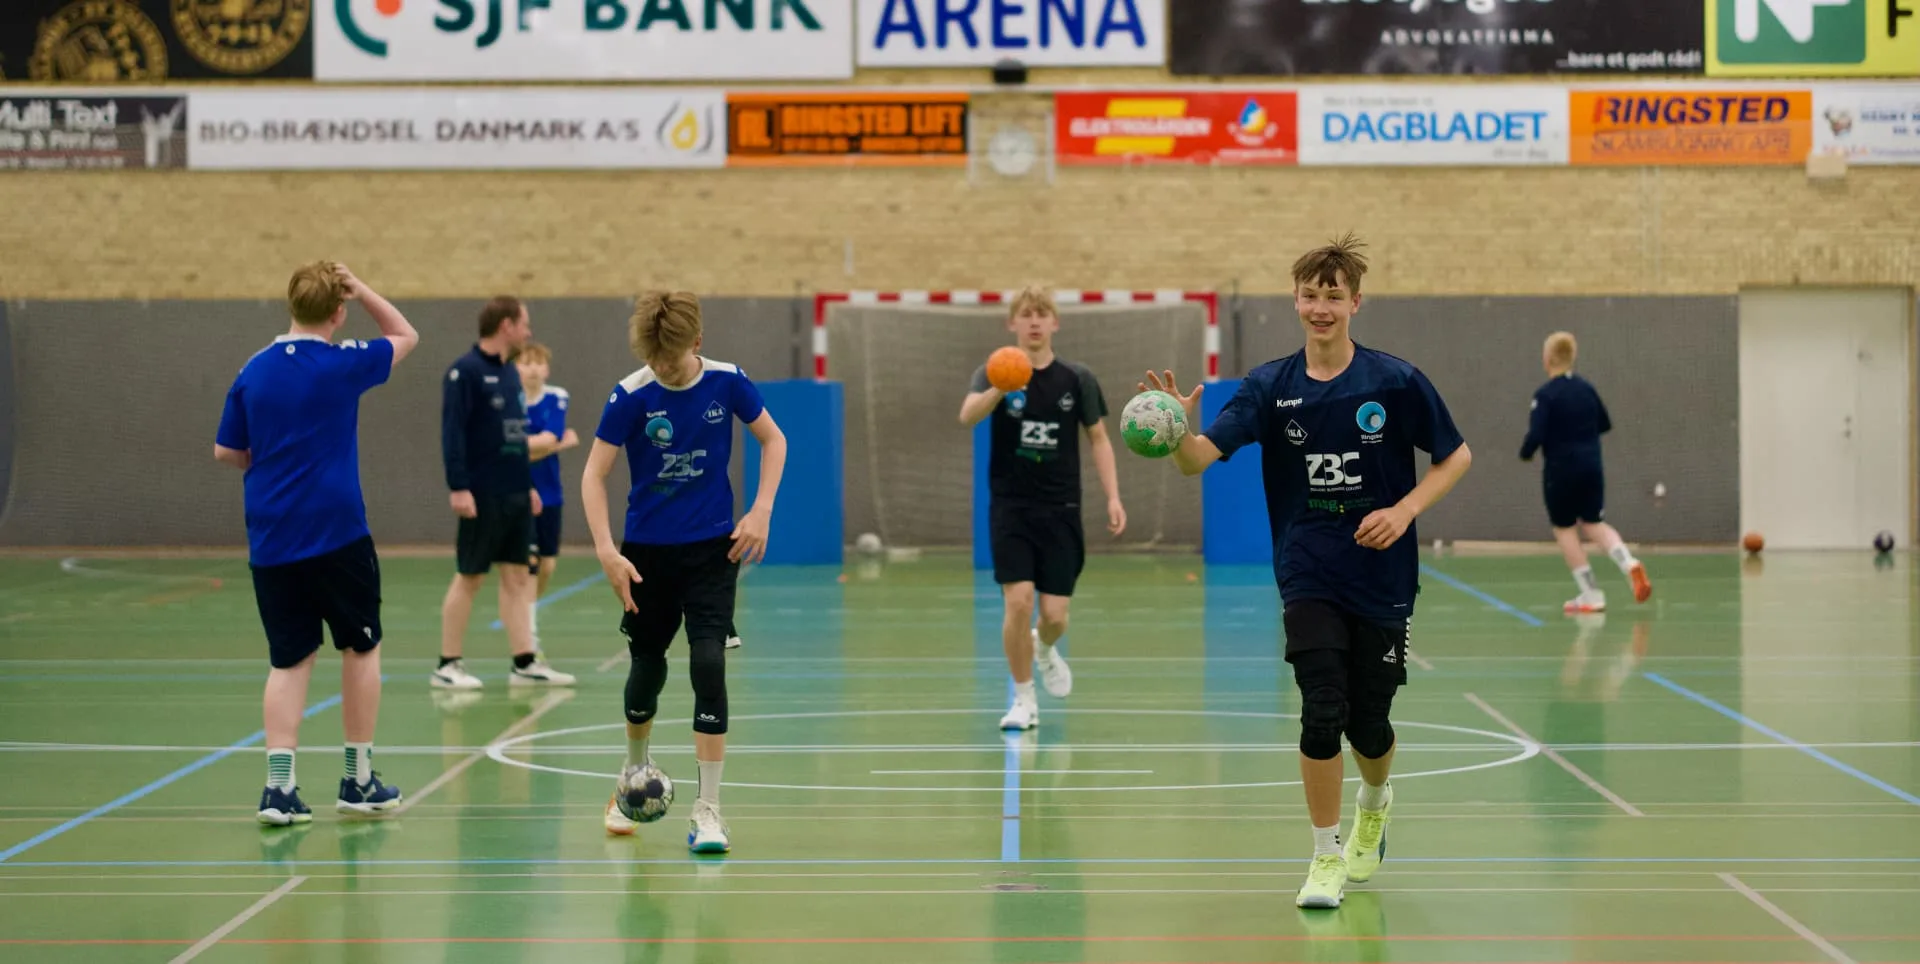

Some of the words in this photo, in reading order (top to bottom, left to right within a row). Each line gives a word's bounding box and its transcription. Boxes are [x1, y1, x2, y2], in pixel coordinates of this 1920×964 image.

[873, 0, 1147, 49] ARENA
[1592, 96, 1790, 125] RINGSTED
[200, 119, 420, 143] BIO-BRÆNDSEL
[436, 119, 585, 142] DANMARK
[595, 119, 639, 142] A/S
[1322, 111, 1548, 142] DAGBLADET
[1305, 451, 1362, 487] ZBC
